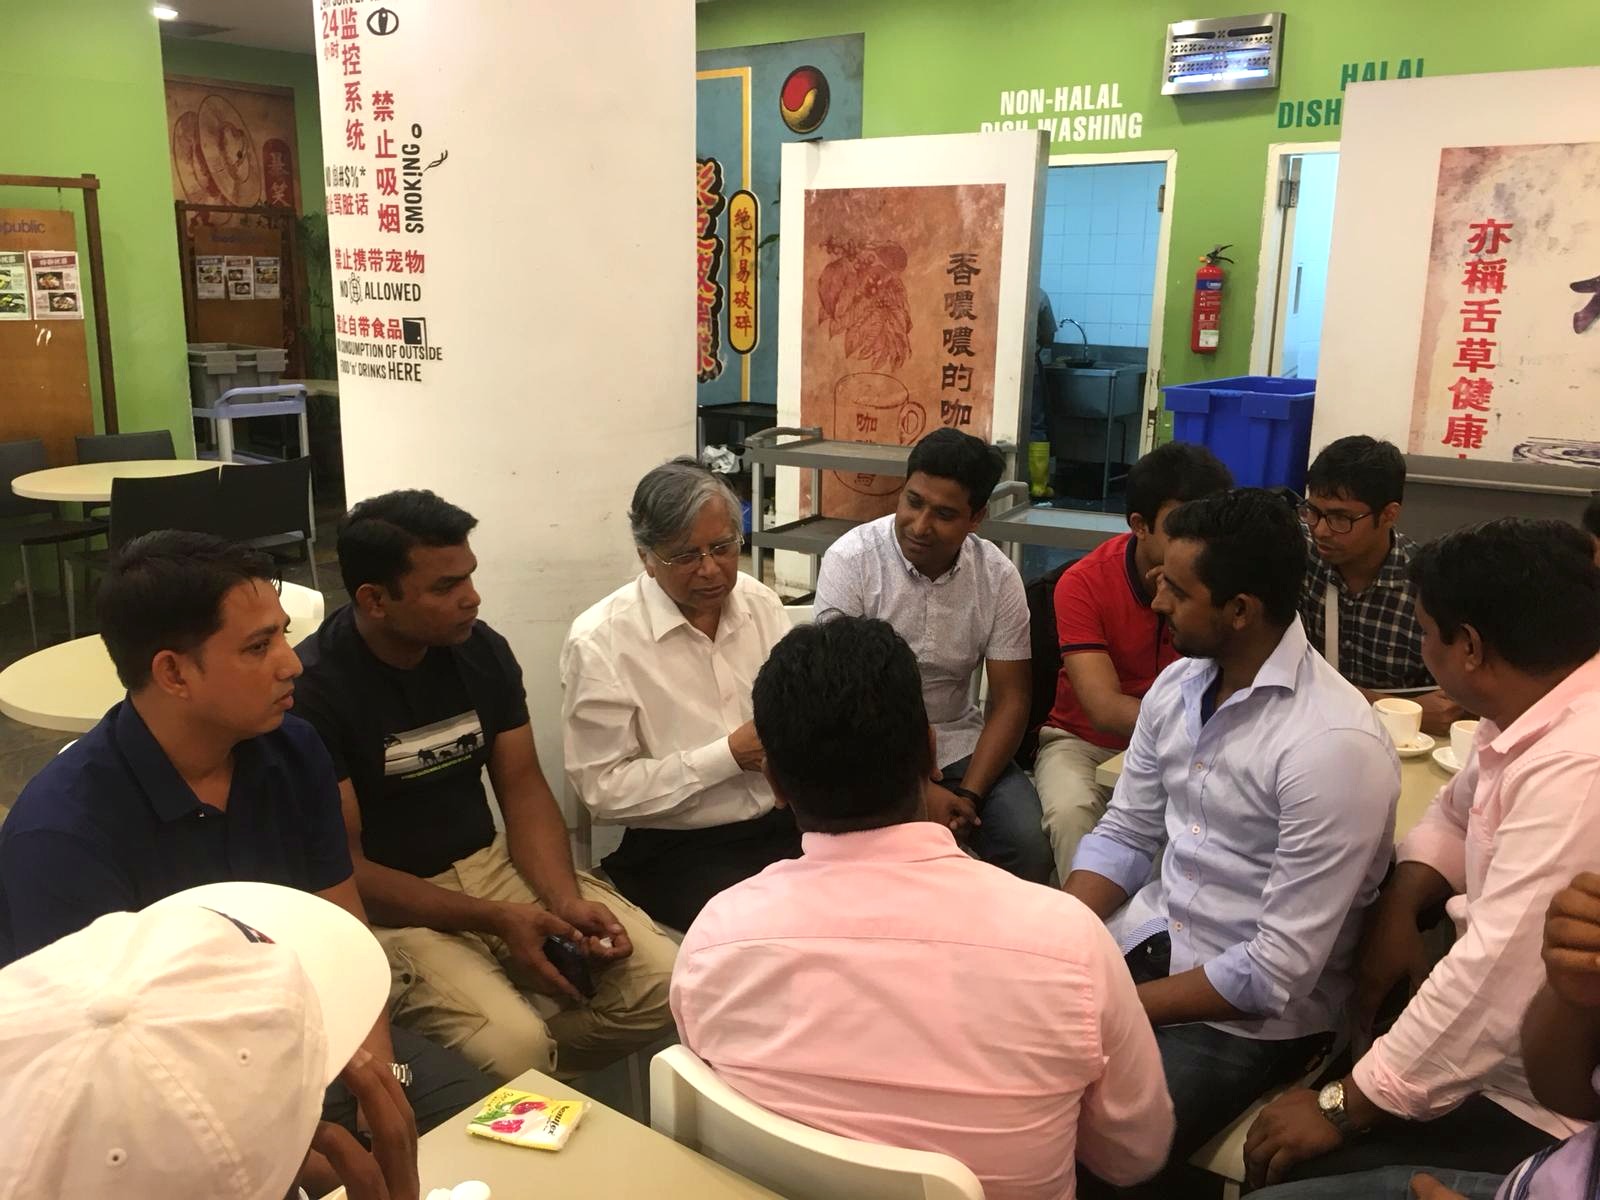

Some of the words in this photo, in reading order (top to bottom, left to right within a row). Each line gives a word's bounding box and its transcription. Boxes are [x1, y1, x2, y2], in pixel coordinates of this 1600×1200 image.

[321, 9, 338, 39] 24
[341, 7, 365, 151] 监控系统
[1000, 83, 1123, 116] NON-HALAL
[1278, 98, 1342, 129] DISH
[372, 90, 401, 234] 禁止吸烟
[335, 248, 425, 274] 禁止携带宠物
[365, 282, 421, 301] ALLOWED
[386, 344, 397, 359] OF
[399, 345, 443, 361] OUTSIDE
[1441, 217, 1514, 459] 亦稱舌草健康
[358, 363, 386, 379] DRINKS
[387, 361, 422, 382] HERE
